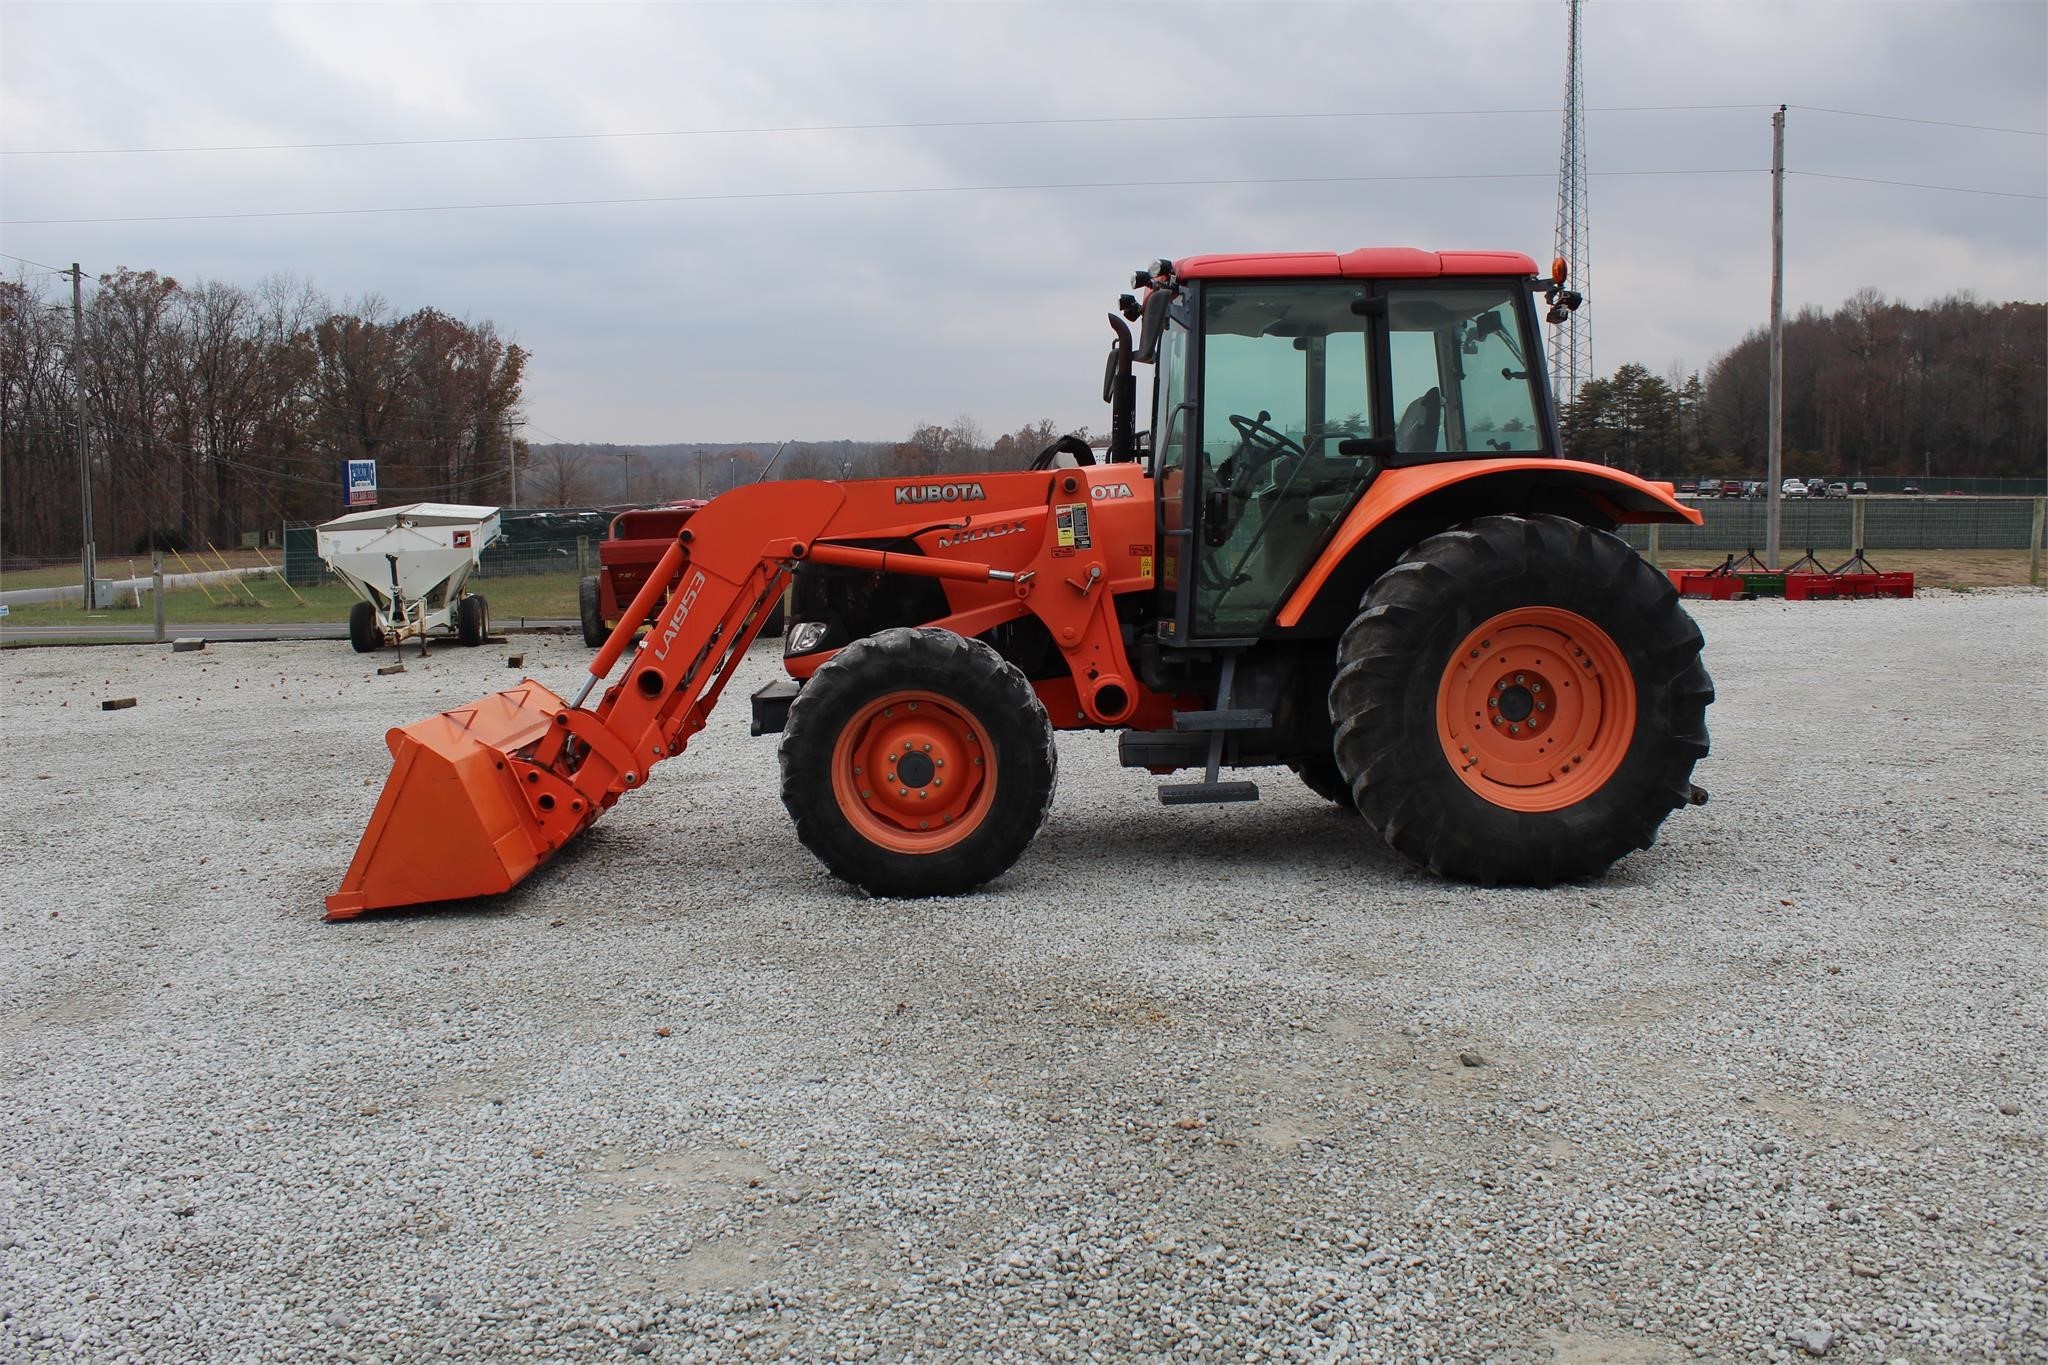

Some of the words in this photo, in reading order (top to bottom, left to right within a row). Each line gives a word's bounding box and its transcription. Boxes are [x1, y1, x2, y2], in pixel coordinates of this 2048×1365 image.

[895, 483, 985, 504] KUBOTA
[1091, 483, 1134, 500] OTA
[654, 571, 706, 661] LA1953
